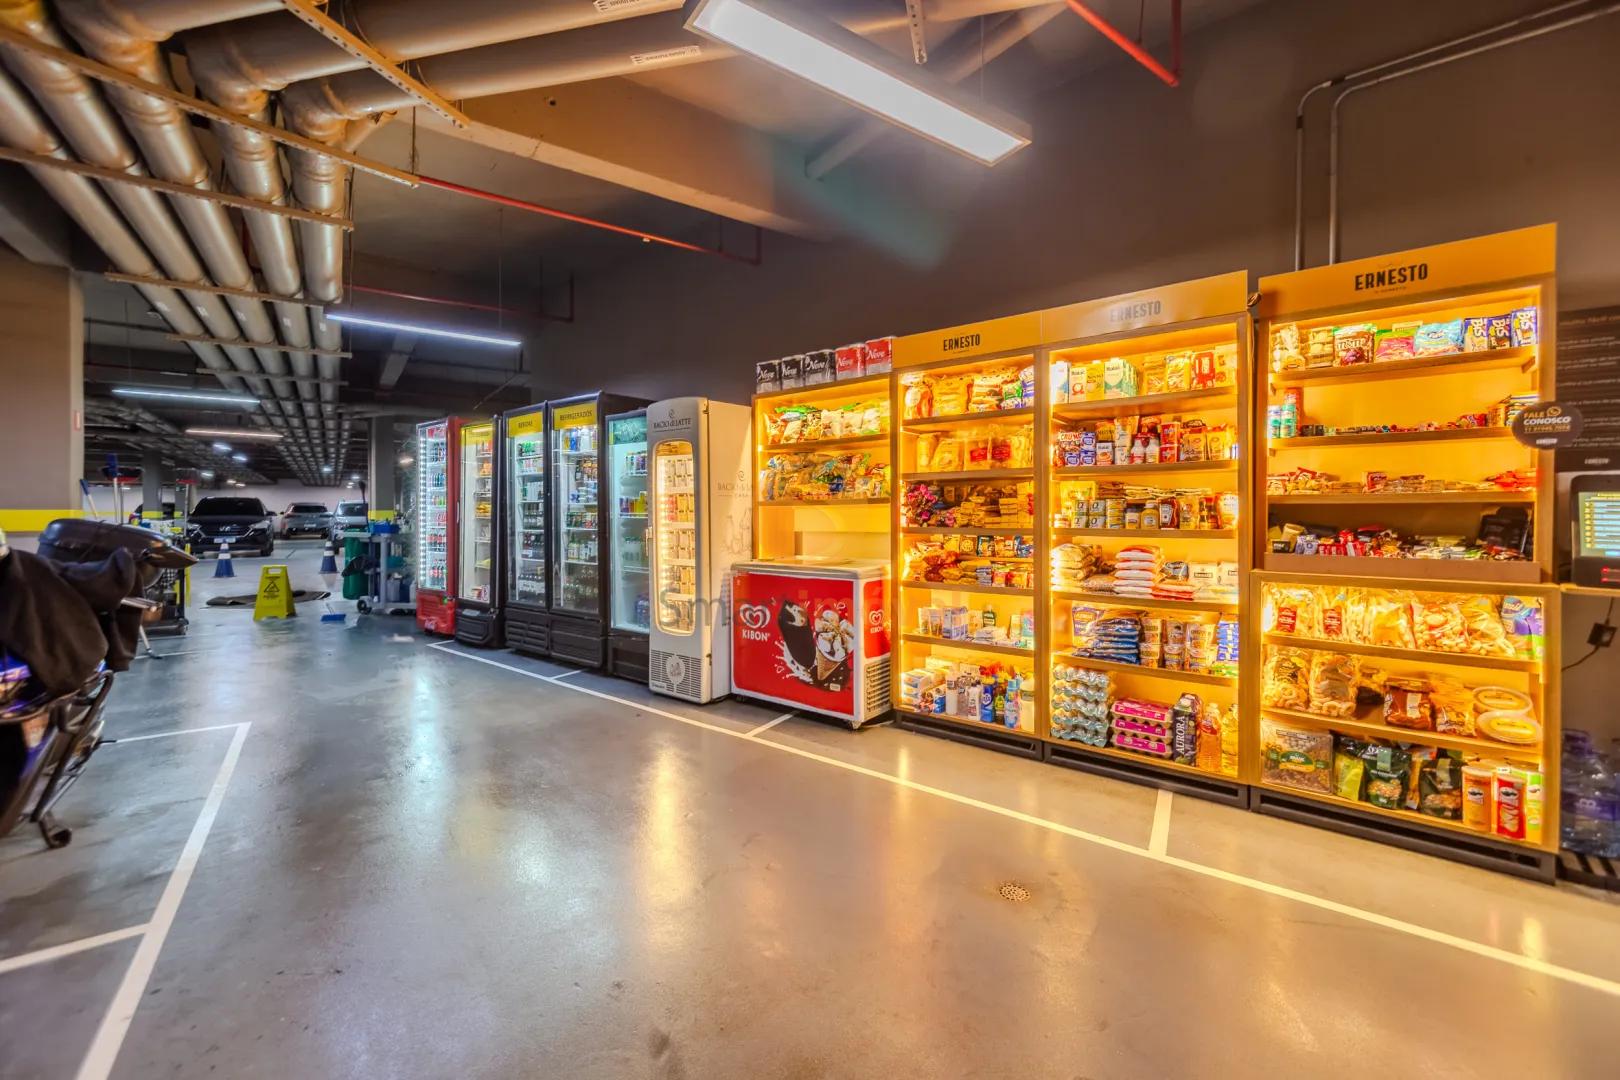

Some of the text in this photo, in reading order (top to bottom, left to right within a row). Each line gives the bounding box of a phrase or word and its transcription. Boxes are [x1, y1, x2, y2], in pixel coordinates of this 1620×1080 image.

[1355, 263, 1428, 291] ERNESTO
[1110, 300, 1161, 322] ERNESTO
[943, 334, 981, 351] ERNESTO
[866, 349, 885, 360] Neve
[807, 360, 826, 371] Neve
[758, 369, 775, 380] Neve
[1523, 411, 1545, 419] FALE
[1523, 416, 1571, 425] CONOSCO
[741, 629, 768, 642] KIBON
[1176, 716, 1185, 755] AURORA
